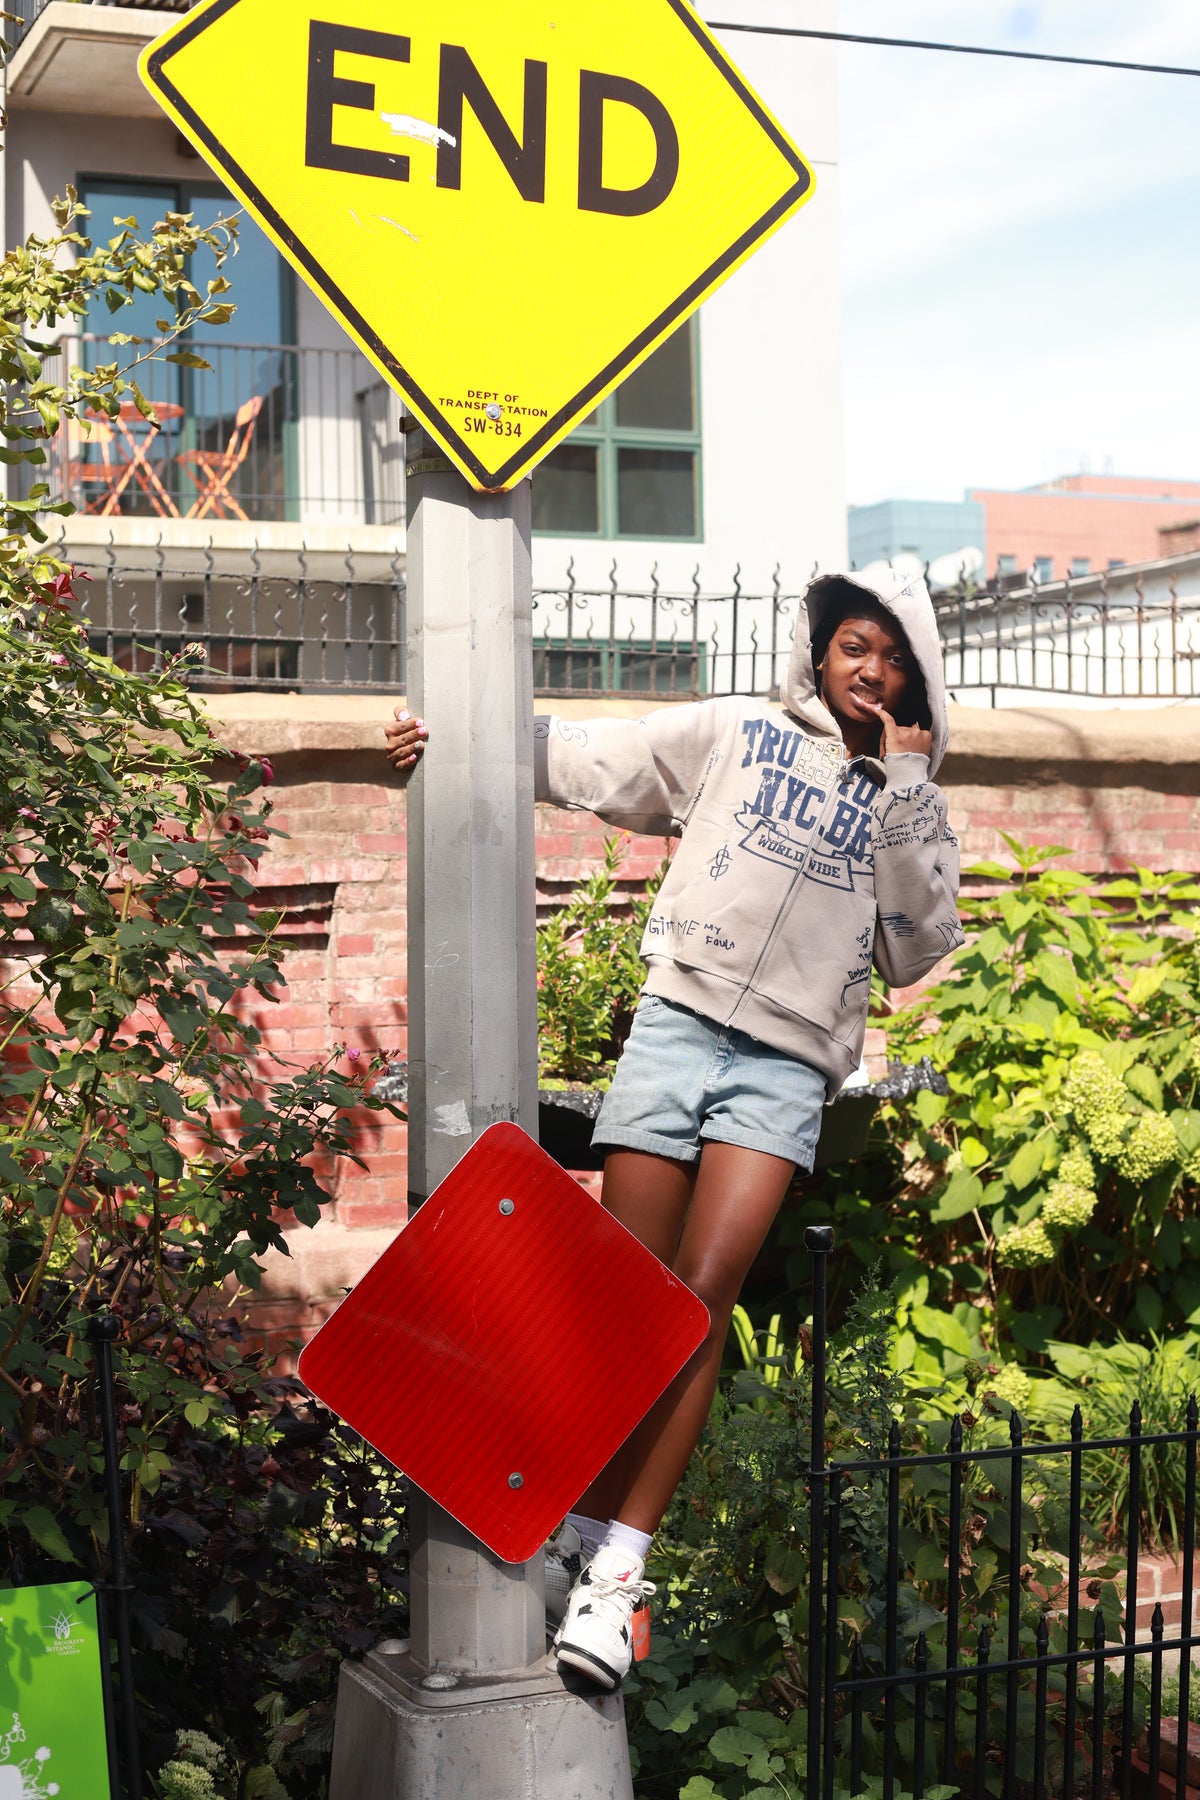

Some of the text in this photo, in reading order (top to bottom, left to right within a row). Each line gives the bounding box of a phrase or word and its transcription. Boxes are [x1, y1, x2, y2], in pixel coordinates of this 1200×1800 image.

[305, 19, 680, 217] END
[467, 390, 519, 403] DEPT OF
[438, 398, 548, 417] TRANSPTATION
[464, 417, 522, 437] SW-834
[757, 838, 805, 863] WORLD
